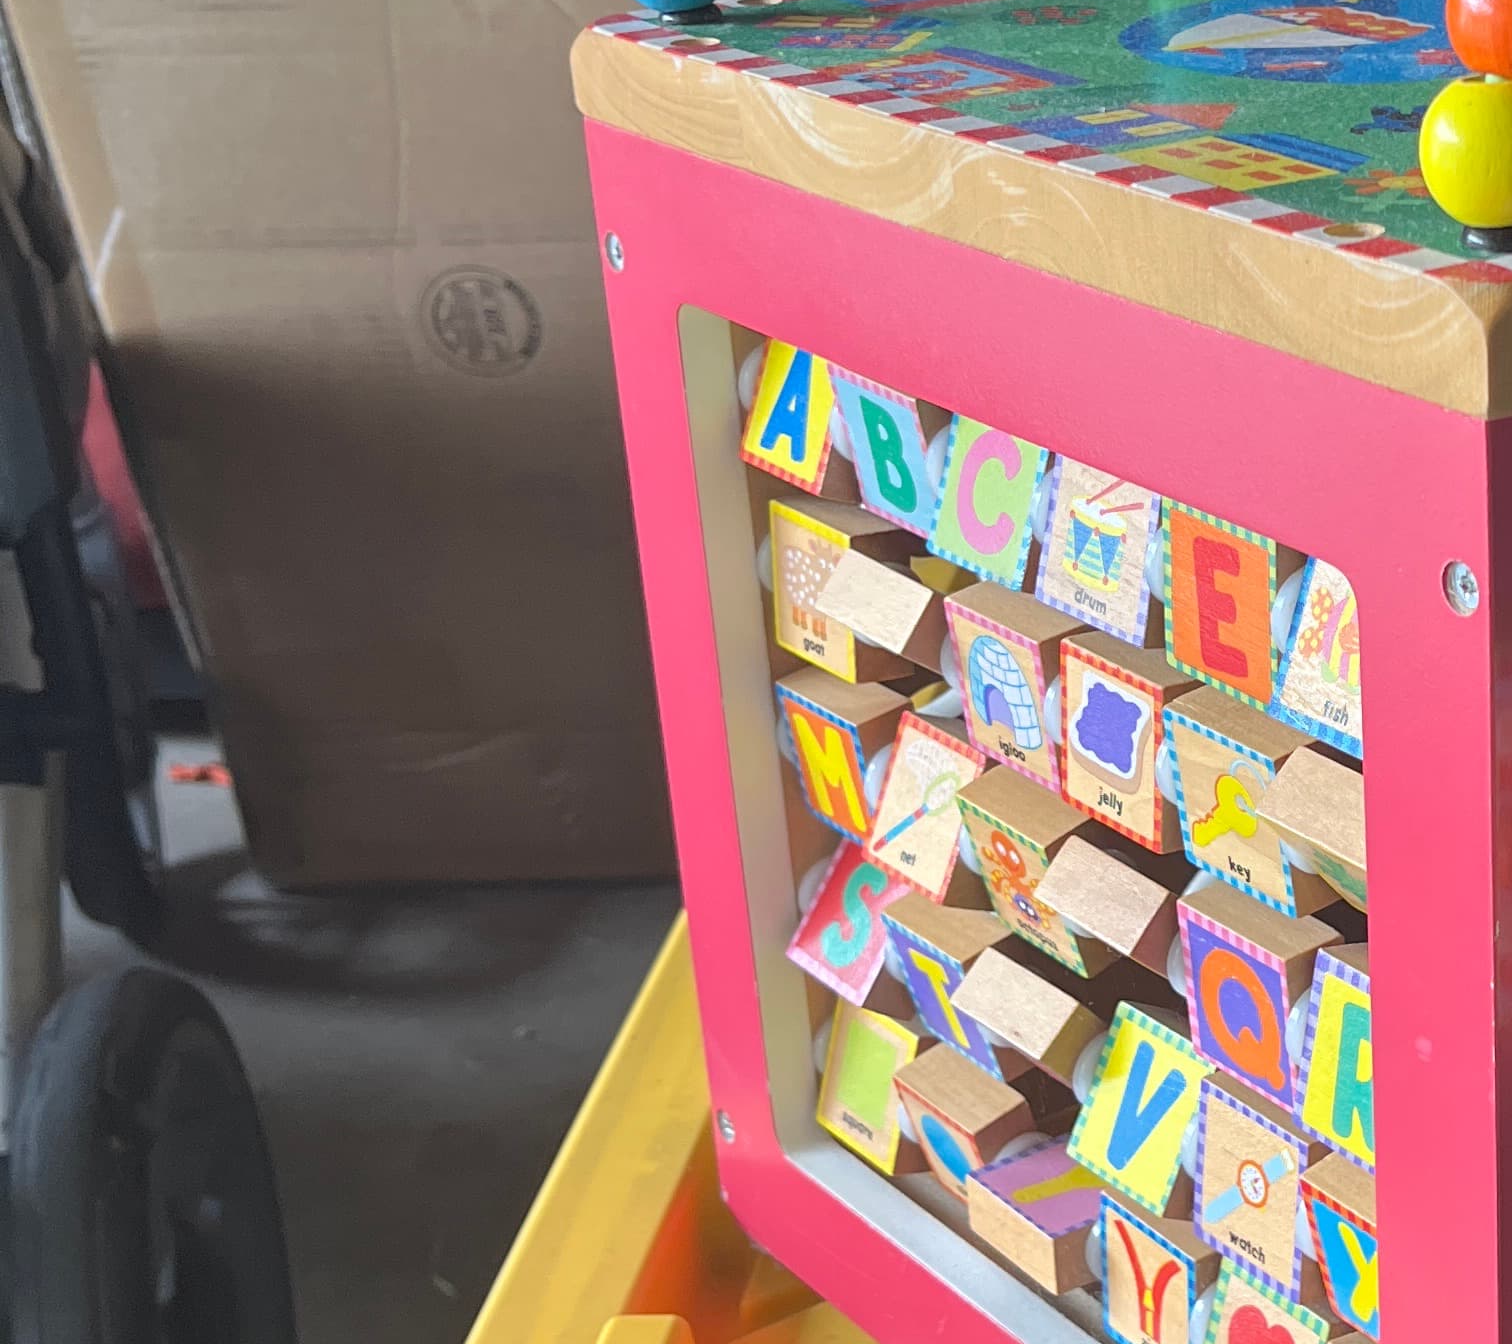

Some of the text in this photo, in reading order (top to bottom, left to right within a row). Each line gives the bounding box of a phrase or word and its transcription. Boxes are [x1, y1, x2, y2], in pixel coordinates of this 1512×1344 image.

[760, 350, 1249, 677] A B C E
[1074, 588, 1108, 616] drum
[1323, 700, 1350, 728] fish
[998, 736, 1026, 762] igloo
[792, 713, 867, 833] M
[1096, 786, 1124, 818] jelly
[1228, 855, 1252, 882] key
[819, 862, 889, 968] S
[907, 947, 971, 1048] T
[1200, 949, 1286, 1091] Q
[1106, 1040, 1187, 1170] V
[1228, 1231, 1266, 1264] watch
